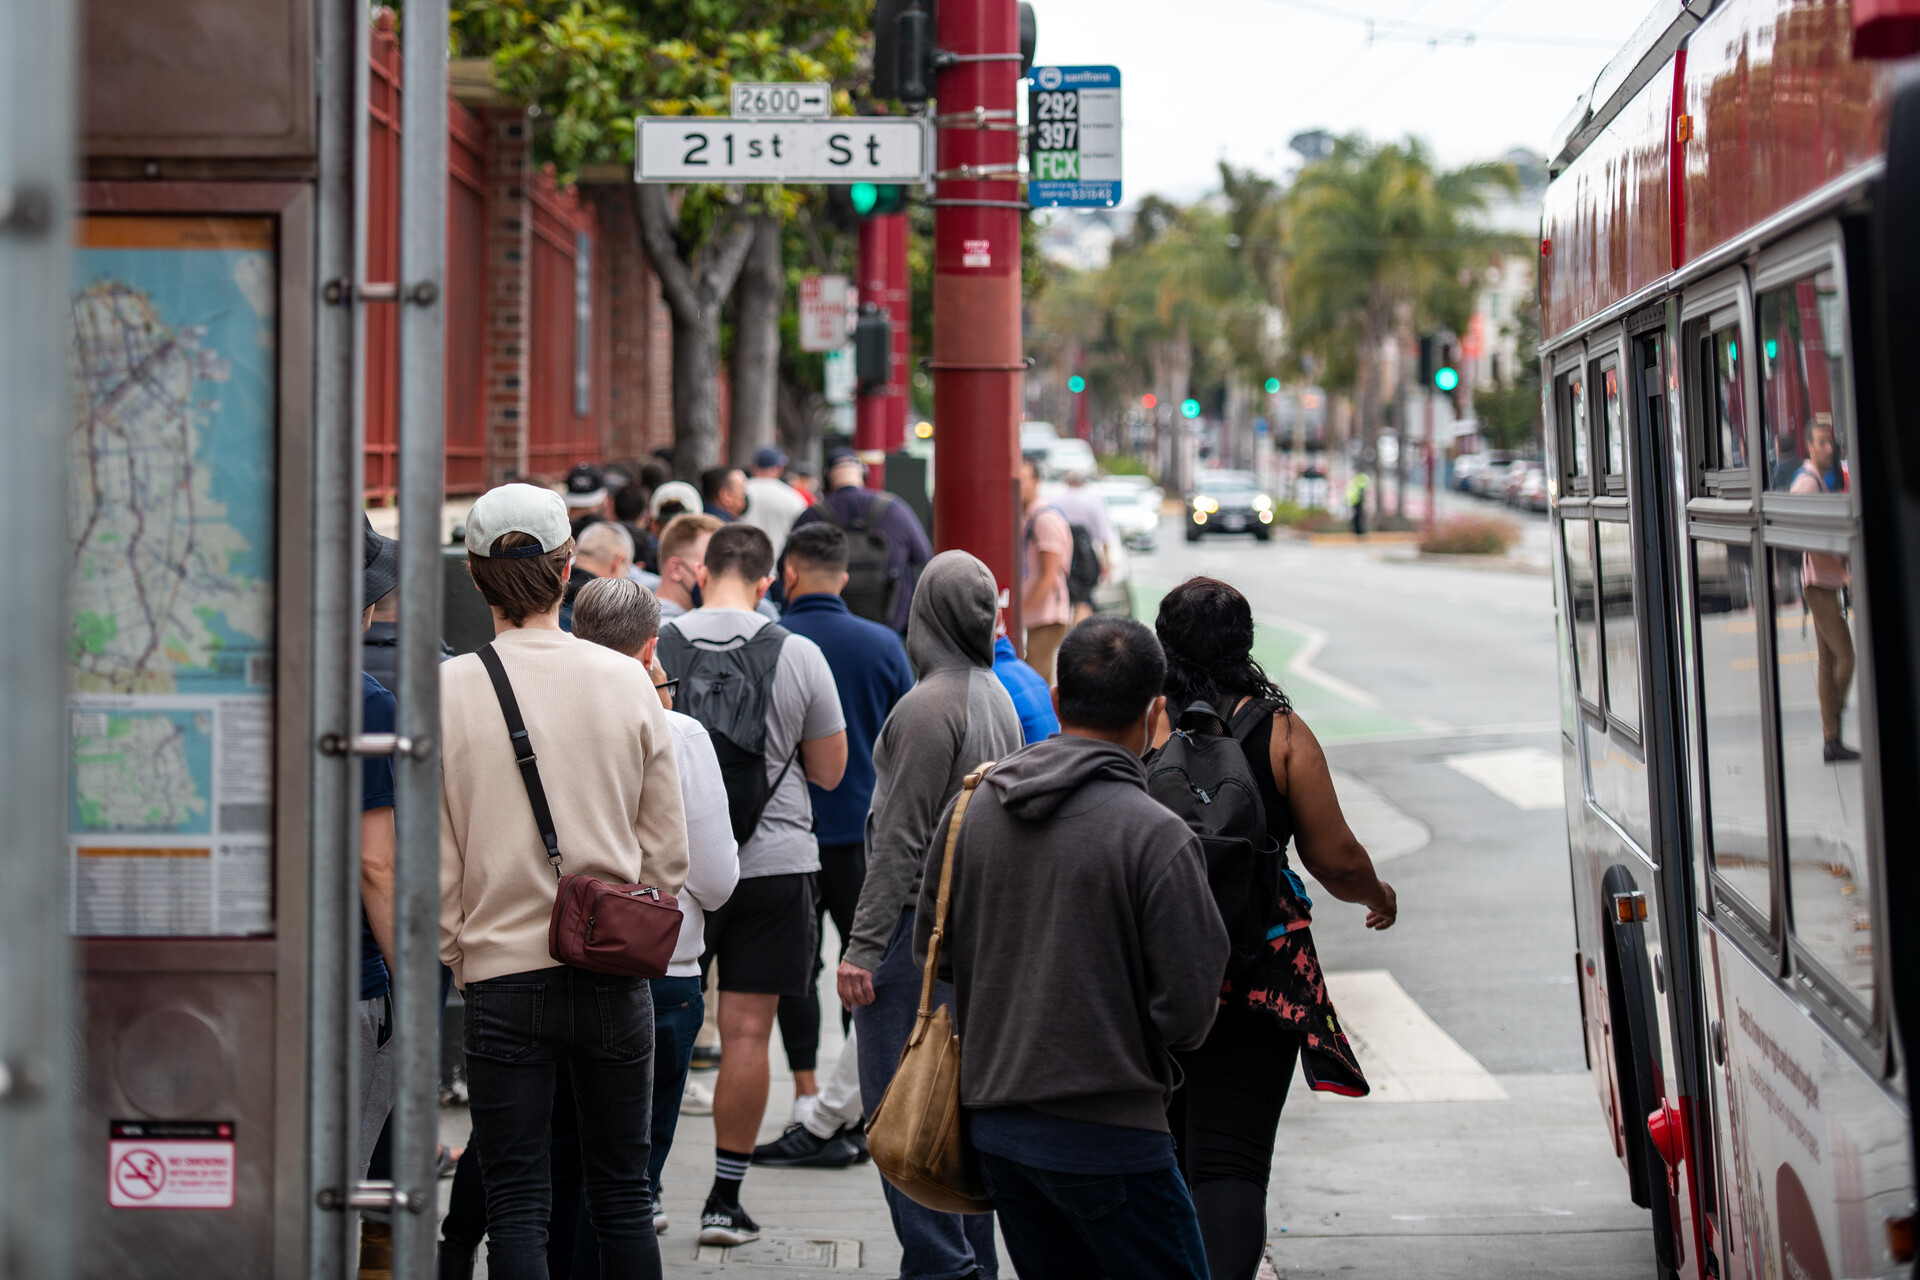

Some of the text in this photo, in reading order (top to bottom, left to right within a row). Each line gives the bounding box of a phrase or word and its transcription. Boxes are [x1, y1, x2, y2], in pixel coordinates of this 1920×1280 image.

[739, 90, 800, 112] 2600
[1037, 91, 1077, 120] 292
[1037, 121, 1078, 149] 397
[682, 133, 880, 166] 21st St
[1036, 151, 1079, 179] FCX
[701, 1212, 732, 1227] didas
